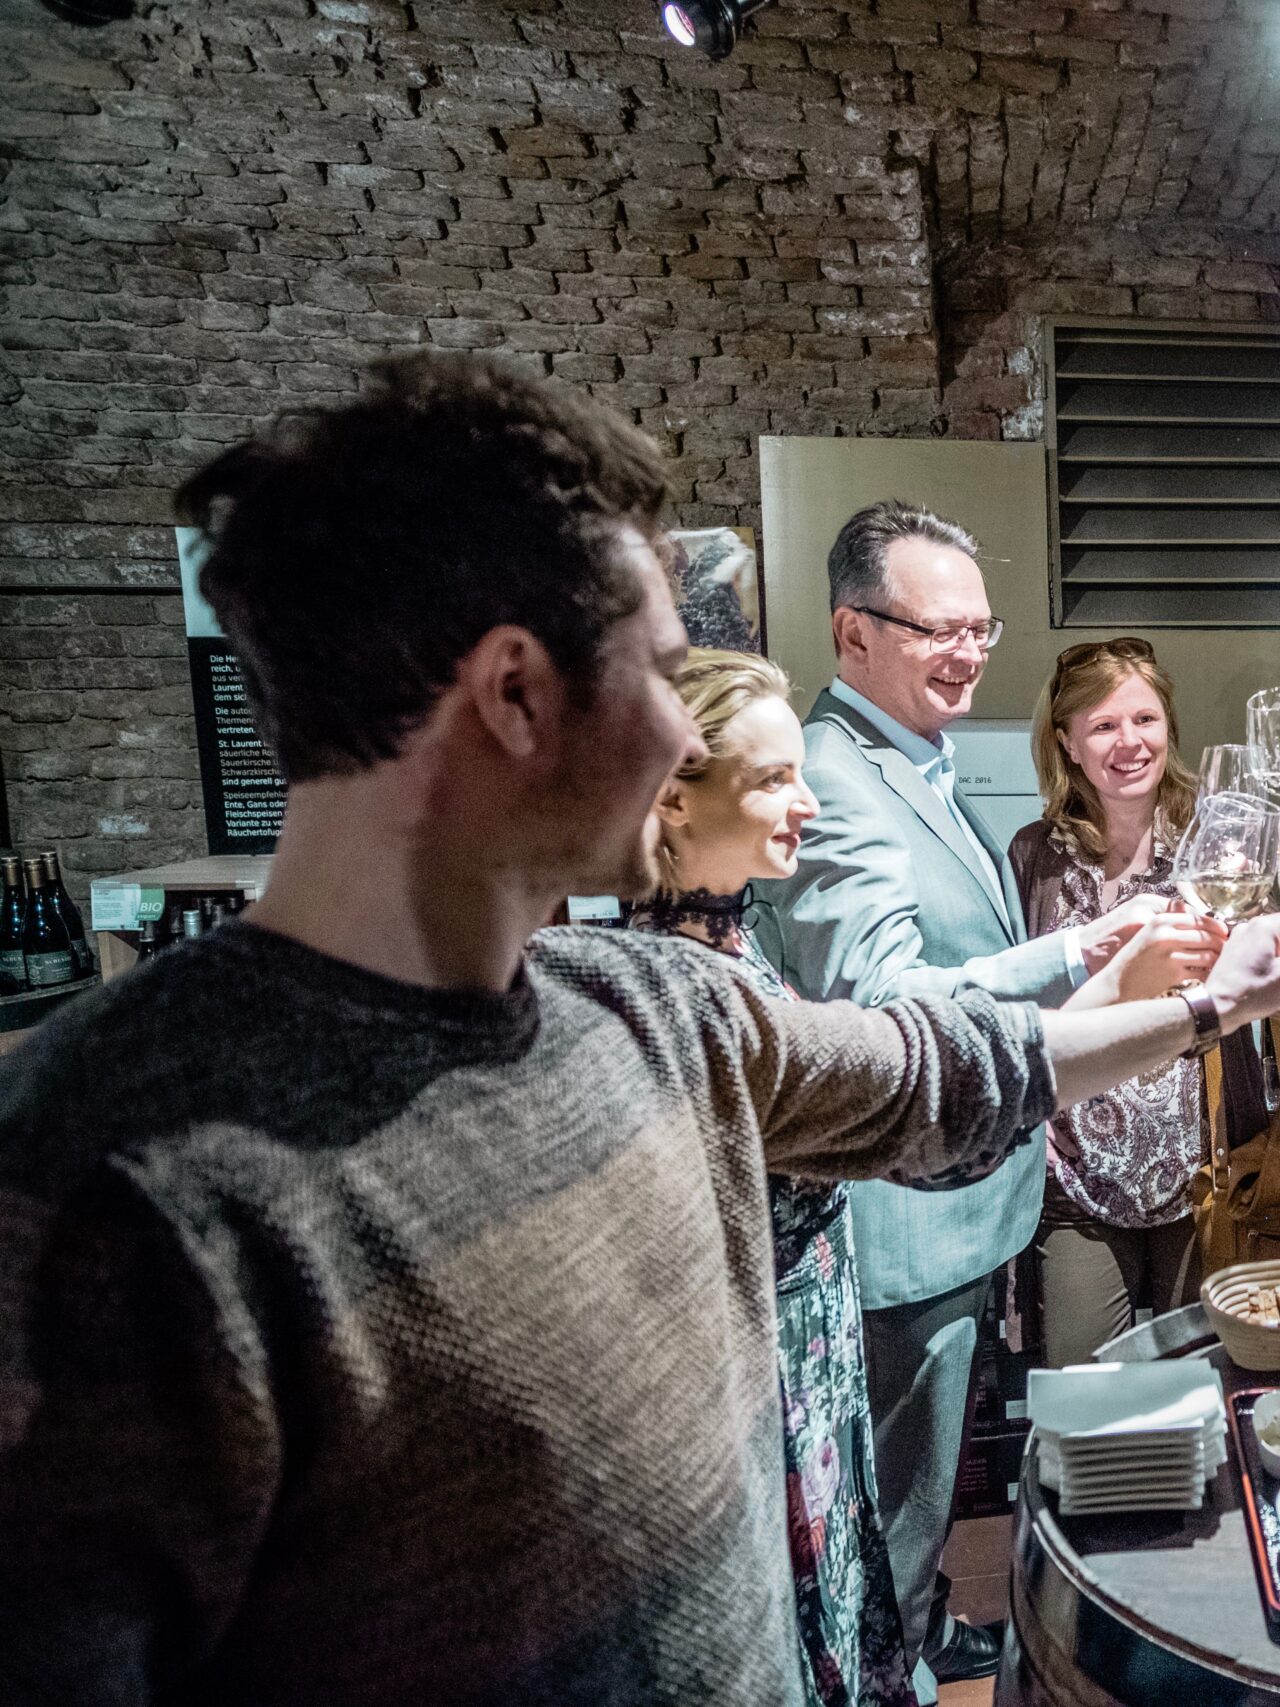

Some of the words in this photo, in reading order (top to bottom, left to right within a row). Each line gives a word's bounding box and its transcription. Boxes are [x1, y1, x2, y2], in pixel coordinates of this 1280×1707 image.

[215, 707, 228, 715] Die
[222, 778, 238, 786] sind
[241, 777, 272, 786] generell
[225, 810, 282, 818] Fleischspeisen
[140, 902, 162, 912] BIO
